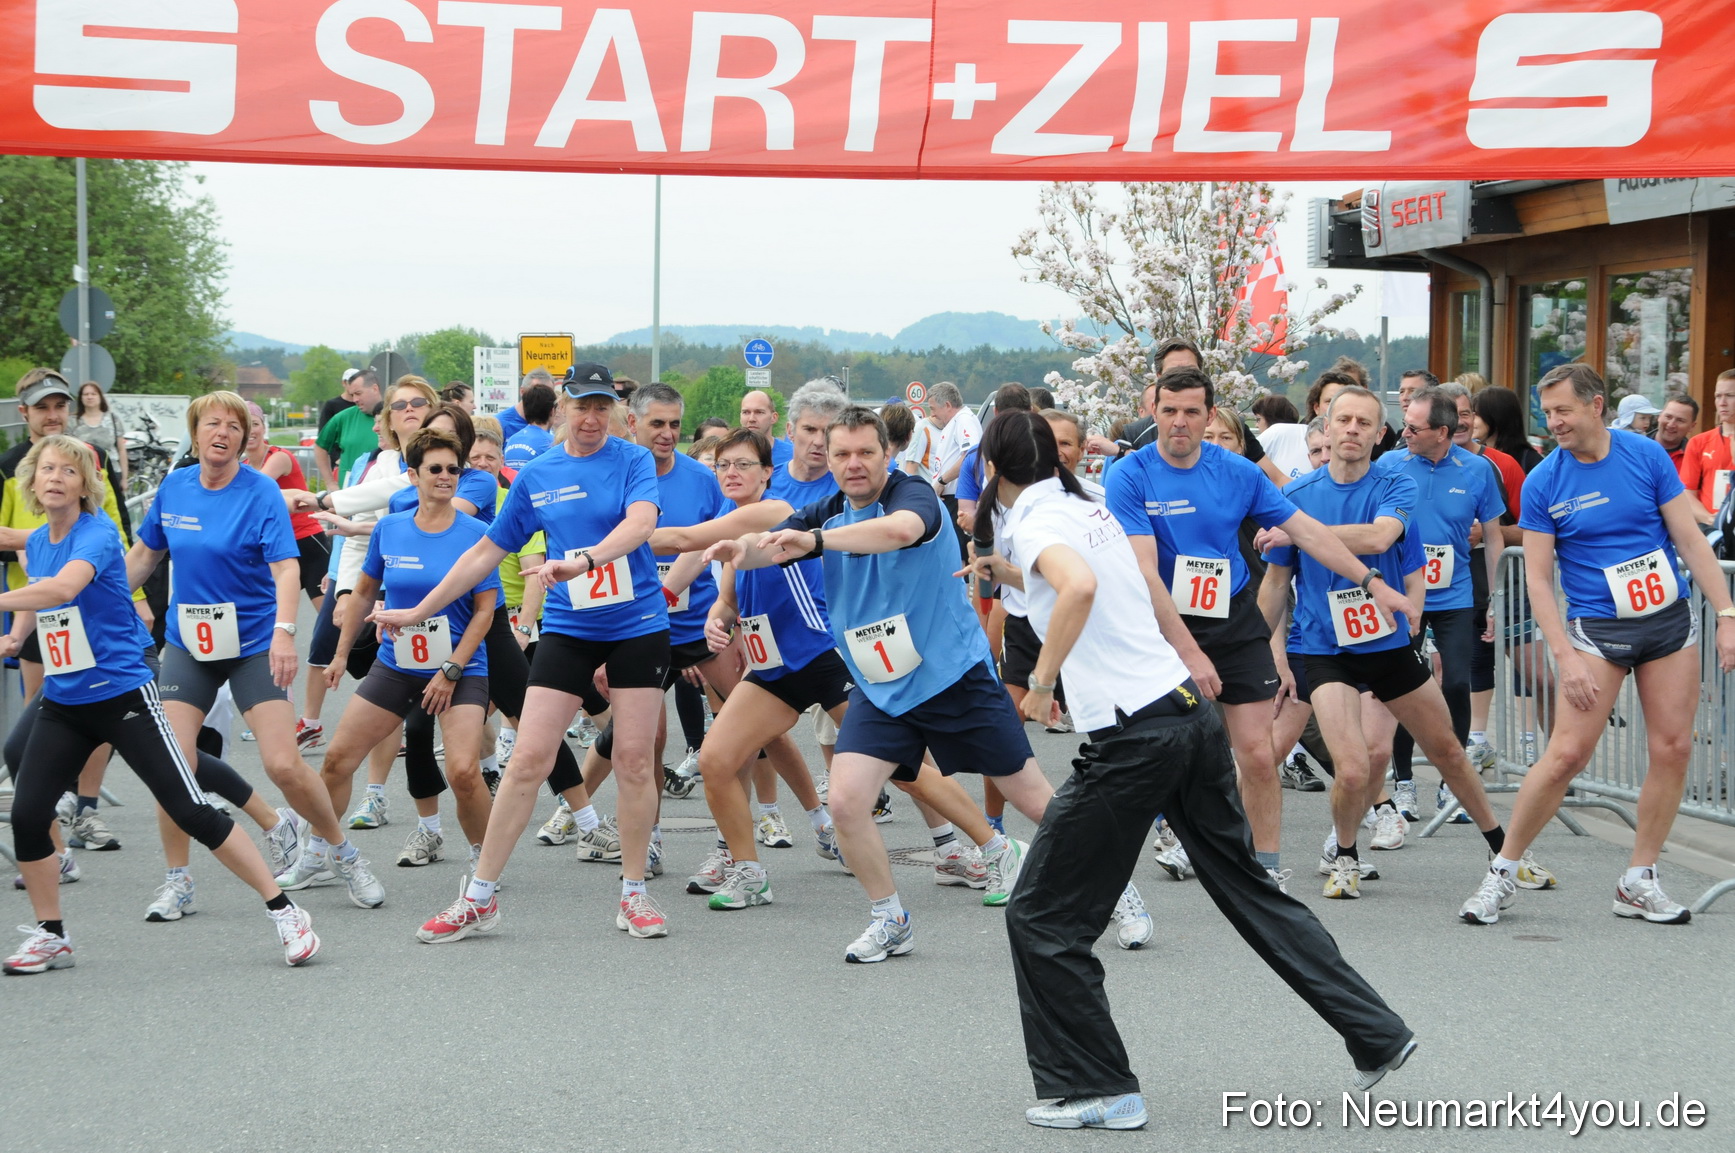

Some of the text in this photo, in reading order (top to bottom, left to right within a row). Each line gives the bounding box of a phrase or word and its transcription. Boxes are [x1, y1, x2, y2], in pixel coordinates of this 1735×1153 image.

[1391, 191, 1446, 228] SEAT
[526, 350, 568, 360] Neumarkt
[911, 388, 922, 399] 60
[1186, 560, 1215, 569] MEYER
[1186, 567, 1214, 575] WERBUNG
[1616, 559, 1646, 574] MEYER
[1618, 566, 1648, 578] WERBUNG
[587, 562, 619, 599] 21
[1190, 576, 1218, 610] 16
[1336, 590, 1362, 600] MEYER
[1627, 573, 1665, 611] 66
[186, 607, 211, 615] MEYER
[1343, 603, 1380, 638] 63
[197, 622, 213, 654] 9
[855, 624, 882, 638] MEYER
[857, 631, 885, 643] WERBUNG
[46, 630, 72, 667] 67
[411, 634, 429, 663] 8
[743, 633, 768, 664] 10
[873, 640, 894, 673] 1
